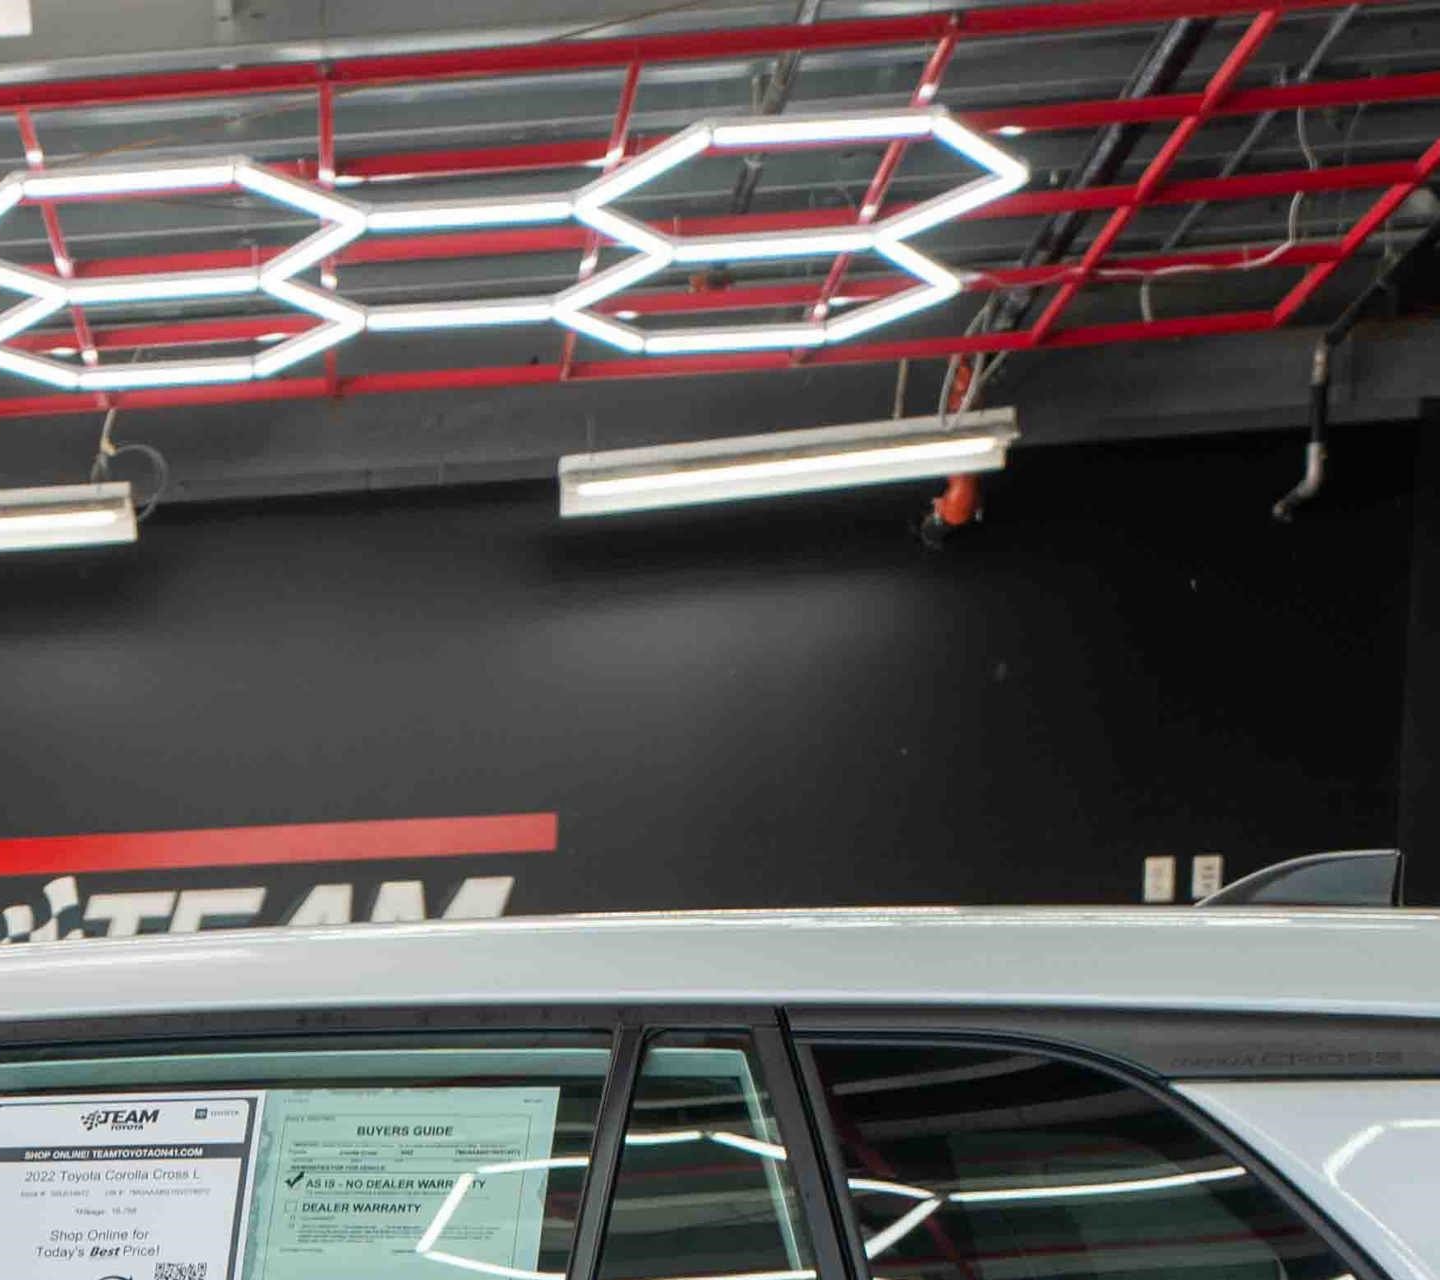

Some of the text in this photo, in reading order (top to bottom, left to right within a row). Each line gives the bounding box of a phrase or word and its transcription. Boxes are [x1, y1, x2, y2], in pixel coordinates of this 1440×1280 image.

[101, 1110, 159, 1123] TEAM
[356, 1125, 454, 1137] BUYERS GUIDE
[25, 1148, 203, 1159] SHOP ONLINE! TEAMTOYOTAON41.COM
[24, 1169, 201, 1184] 2022 Toyota Corolla Cross L
[306, 1178, 322, 1190] AS
[323, 1178, 336, 1189] IS
[346, 1178, 363, 1190] NO
[366, 1178, 415, 1189] DEALER
[417, 1178, 486, 1190] WARRTY
[302, 1202, 422, 1214] DEALER WARRANTY
[49, 1229, 149, 1243] Shop Online for
[36, 1244, 160, 1258] Today's Best Price!
